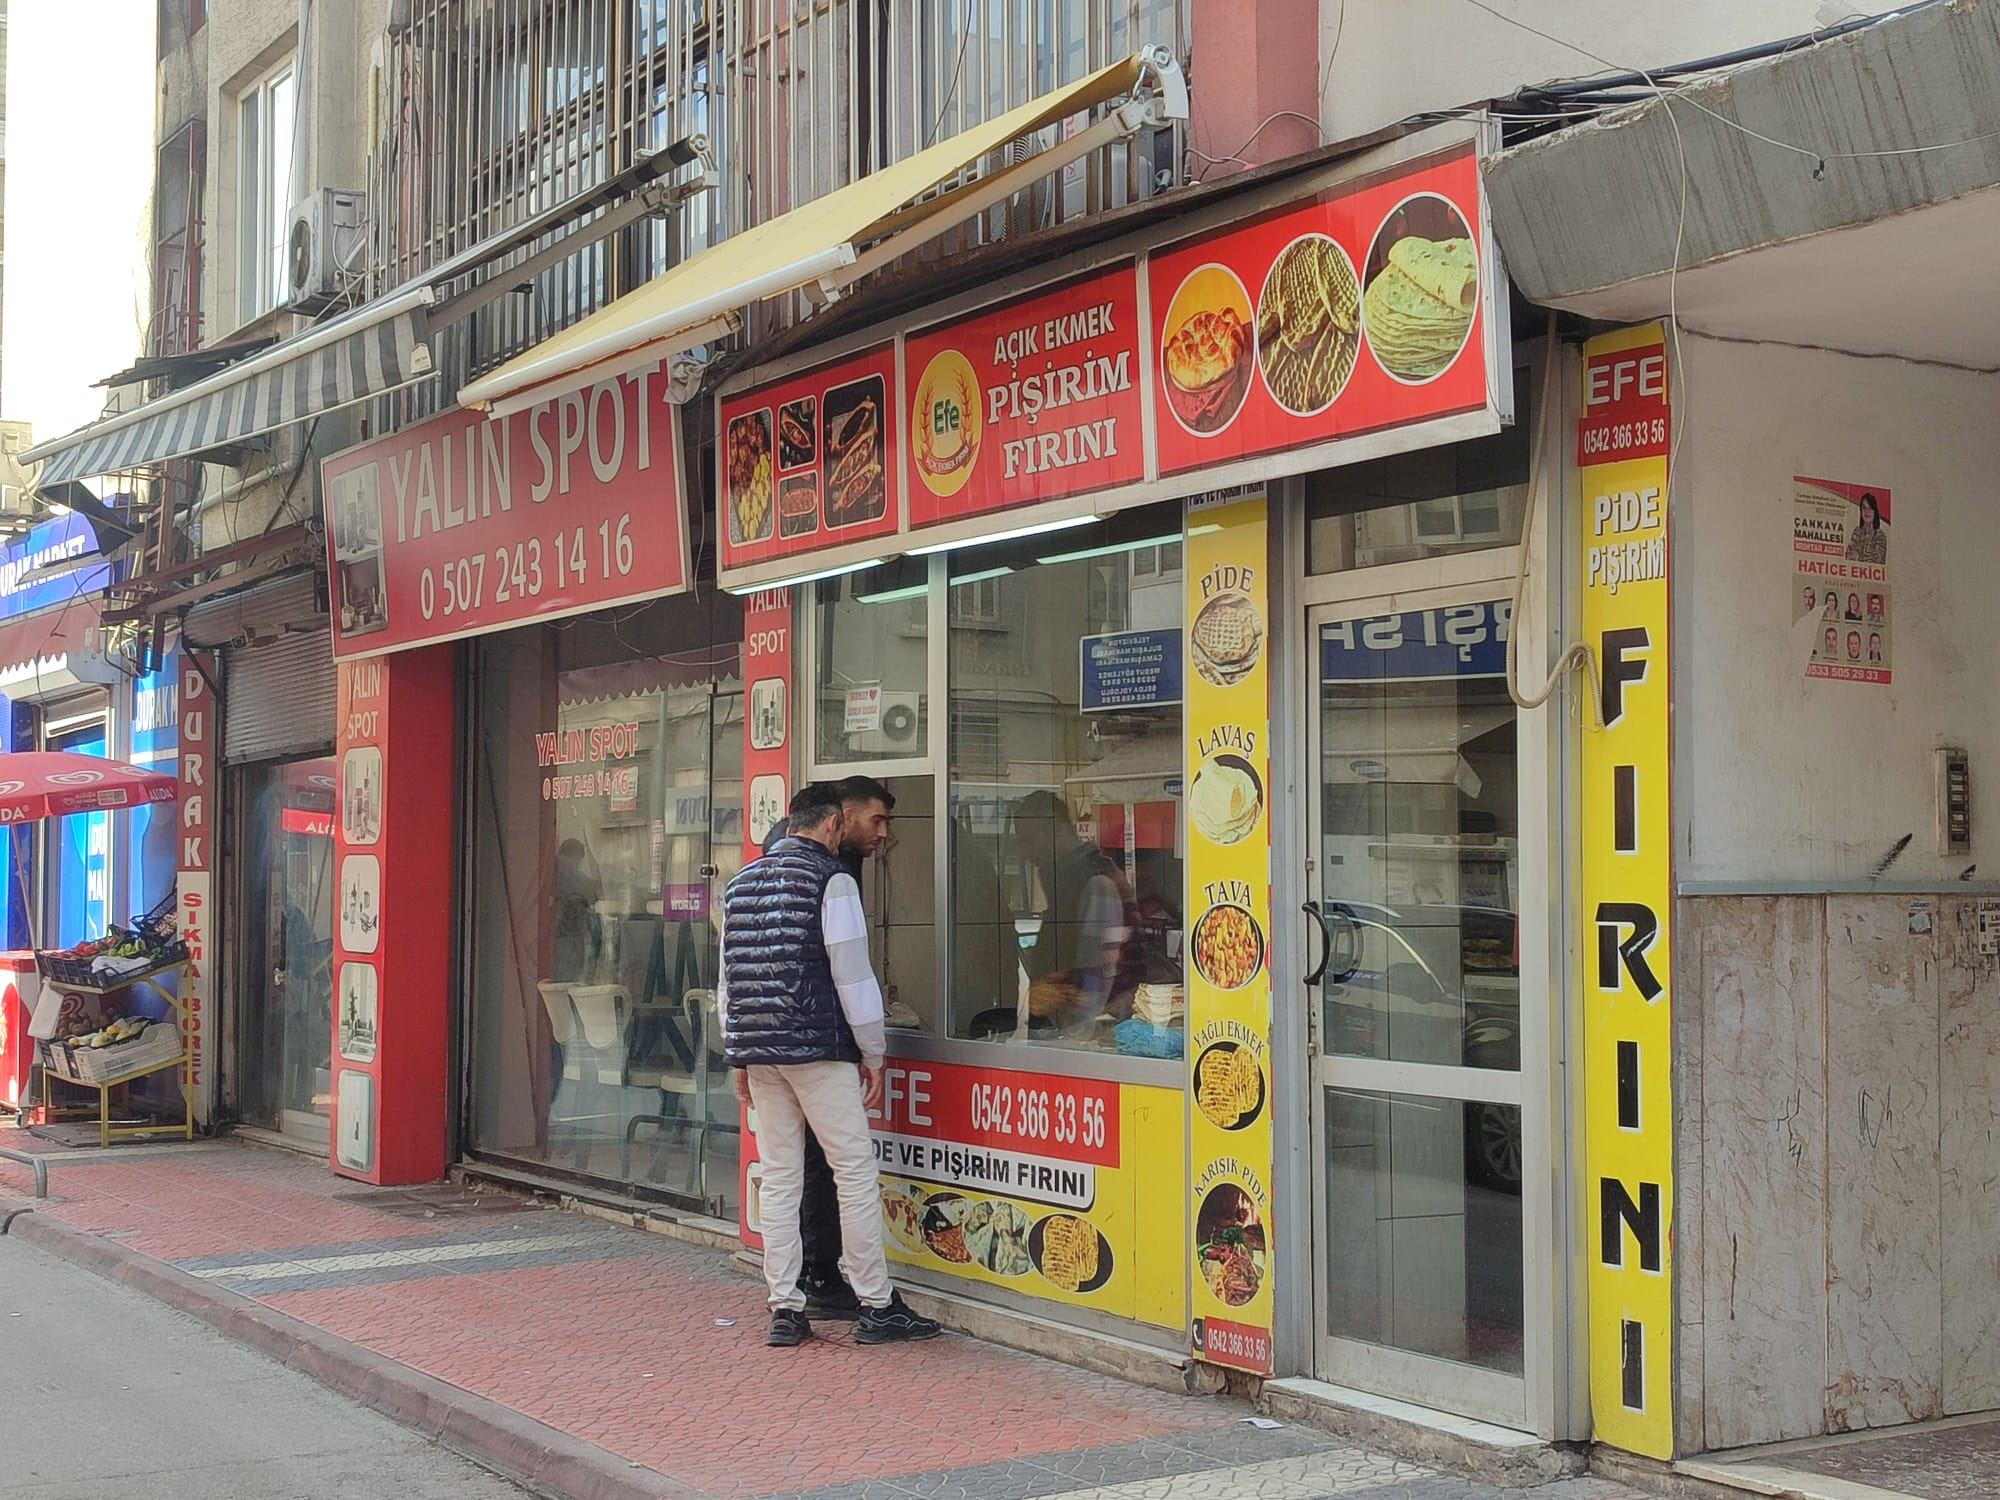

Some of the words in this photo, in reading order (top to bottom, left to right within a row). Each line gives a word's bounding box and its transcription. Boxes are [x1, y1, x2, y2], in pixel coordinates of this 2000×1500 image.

[993, 325, 1039, 368] AÇIK
[1044, 302, 1115, 350] EKMEK
[987, 350, 1132, 424] PİŞİRİM
[1586, 354, 1664, 406] EFE
[933, 400, 960, 434] Efe
[1584, 426, 1610, 455] 0542
[1612, 424, 1632, 448] 366
[1634, 422, 1648, 446] 33
[1651, 417, 1665, 444] 56
[387, 415, 512, 544] YALIN
[529, 358, 661, 503] SPOT
[1003, 418, 1118, 479] FIRINI
[1794, 517, 1844, 532] ÇANKAYA
[1794, 529, 1844, 545] MAHALLESİ
[420, 567, 435, 620] 0
[443, 553, 487, 616] 507
[495, 538, 543, 603] 243
[555, 527, 587, 590] 14
[599, 512, 633, 578] 16
[1200, 562, 1255, 599] PİDE
[1798, 559, 1847, 577] HATİCE
[1851, 565, 1886, 581] EKİCİ
[748, 586, 788, 614] YALIN
[749, 628, 787, 657] SPOT
[346, 663, 381, 699] YALIN
[1831, 667, 1850, 678] 505
[1866, 671, 1879, 682] 33
[135, 687, 168, 733] DURAK
[347, 710, 378, 740] SPOT
[535, 728, 586, 767] YALIN
[590, 721, 639, 761] SPOT
[1197, 725, 1256, 760] LAVAŞ
[184, 670, 205, 867] DURAK
[543, 778, 552, 801] 0
[552, 776, 573, 800] 507
[574, 773, 595, 798] 243
[598, 770, 611, 796] 14
[612, 771, 628, 794] 16
[1204, 880, 1252, 908] TAVA
[1594, 626, 1664, 1412] FIRINI
[1193, 1020, 1224, 1049] YAĞLI
[1227, 1020, 1264, 1058] EKMEK
[866, 1068, 933, 1127] FE
[970, 1082, 1012, 1134] 0542
[1017, 1087, 1049, 1140] 366
[1054, 1092, 1077, 1144] 33
[1082, 1097, 1105, 1148] 56
[899, 1143, 925, 1170] VE
[931, 1144, 1010, 1184] PİŞİRİM
[1017, 1163, 1086, 1197] FIRINI
[1194, 1157, 1239, 1198] KARIŞIK
[1241, 1170, 1267, 1208] PİDE
[1208, 1327, 1227, 1353] 0542
[1228, 1332, 1243, 1356] 366
[1244, 1335, 1254, 1359] 33
[1255, 1337, 1266, 1362] 56
